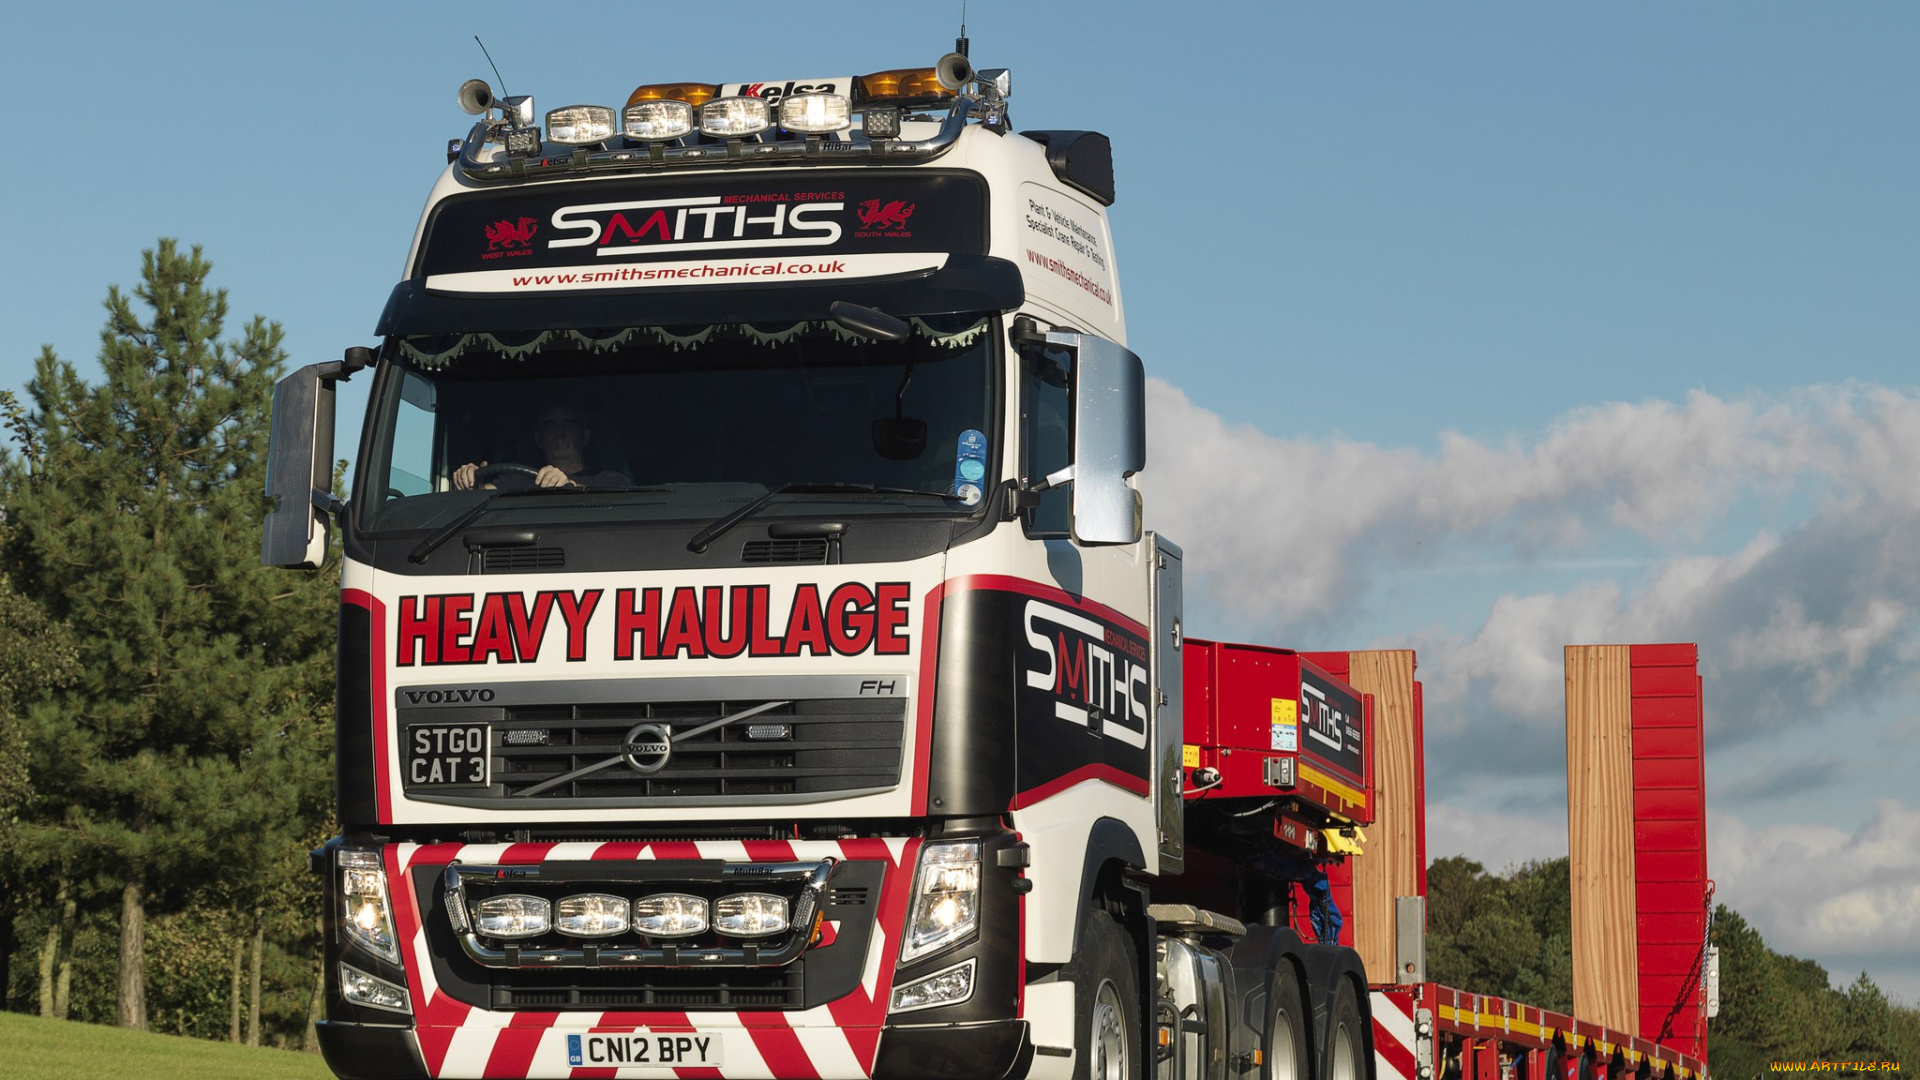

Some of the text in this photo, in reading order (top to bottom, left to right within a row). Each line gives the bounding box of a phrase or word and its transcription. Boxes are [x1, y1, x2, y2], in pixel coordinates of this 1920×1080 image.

[737, 81, 836, 106] Kelsa
[724, 191, 845, 204] MECHANICAL SERVICES
[548, 197, 845, 257] SMITHS
[1029, 199, 1046, 217] Plant
[1046, 206, 1052, 220] &
[1052, 209, 1070, 229] Vehicle
[1026, 214, 1055, 238] Specialist
[1055, 227, 1071, 247] Crane
[1070, 235, 1086, 255] Repair
[481, 249, 533, 260] WEST WALES
[512, 260, 846, 287] www.smithsmechanical.co.uk
[1026, 248, 1113, 307] www.smithsmechanical.co.uk
[396, 581, 911, 668] HEAVY HAULAGE
[859, 680, 896, 695] FH
[1024, 599, 1148, 750] SMITHS
[404, 688, 495, 705] VOLVO
[1301, 681, 1342, 752] SMITHS
[415, 728, 482, 754] STGO
[626, 744, 668, 752] VOLVO
[411, 757, 485, 783] CAT 3
[495, 868, 527, 879] Kelsa
[733, 867, 774, 876] MultiBar
[569, 1055, 582, 1063] GB
[588, 1037, 711, 1063] CN12 BPY
